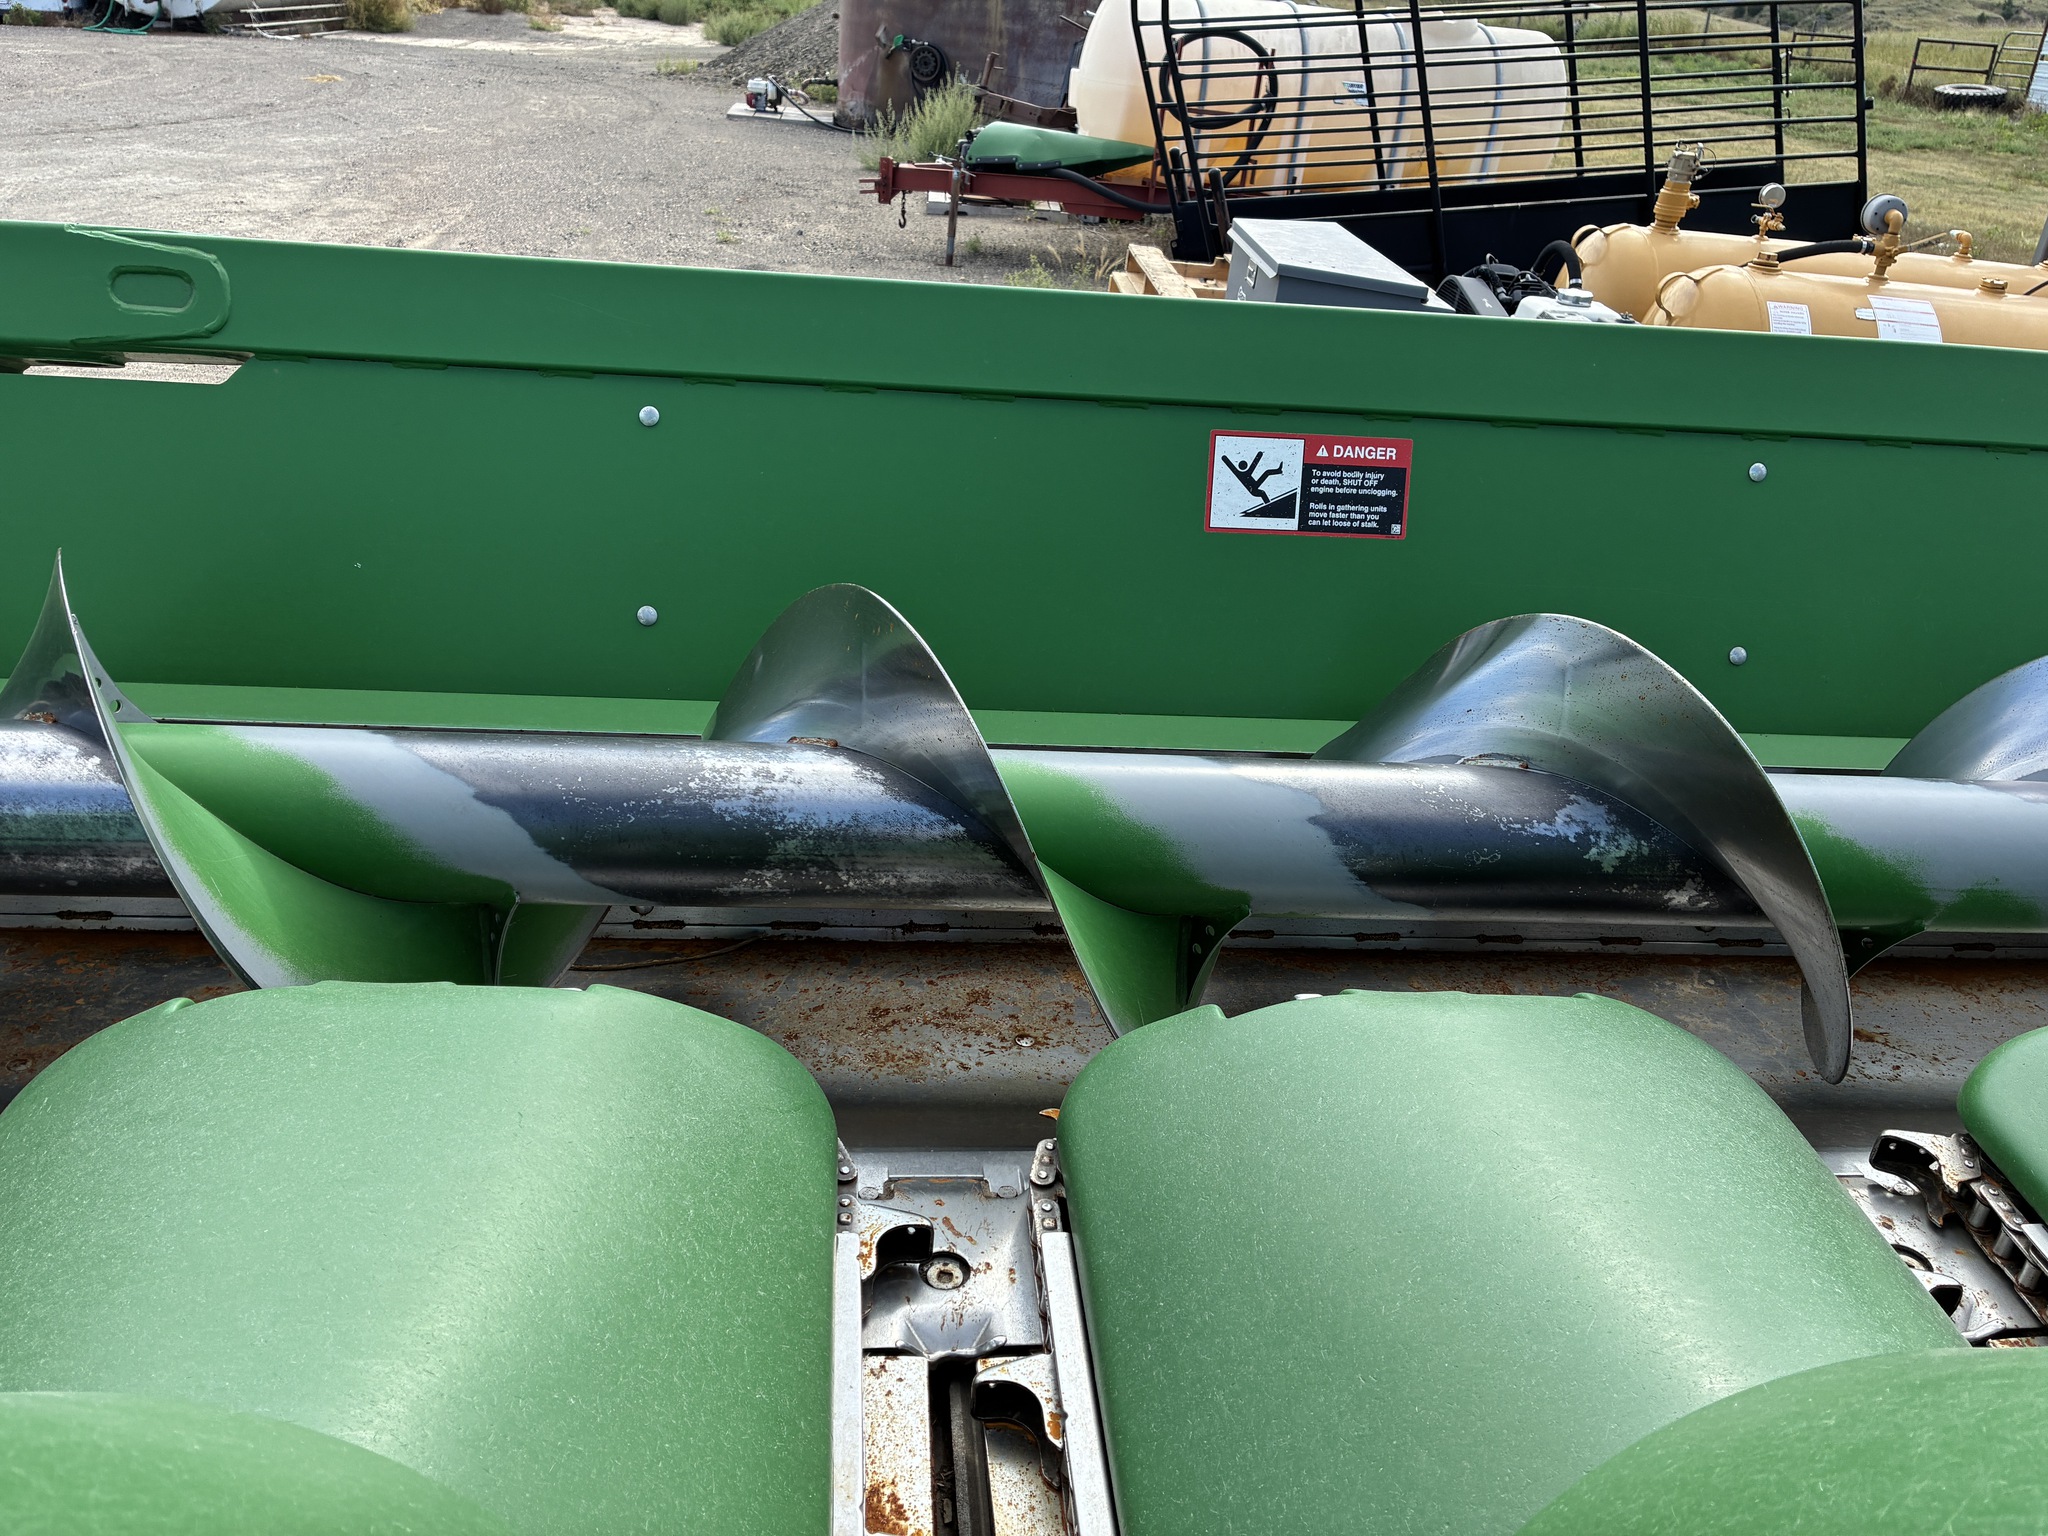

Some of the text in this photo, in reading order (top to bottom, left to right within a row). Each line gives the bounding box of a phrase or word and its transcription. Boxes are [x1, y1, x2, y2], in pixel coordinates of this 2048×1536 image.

[1333, 445, 1397, 460] DANGER
[1312, 469, 1321, 477] To
[1342, 471, 1364, 479] bodily
[1365, 472, 1385, 480] injury
[1320, 478, 1341, 486] death,
[1310, 486, 1334, 494] engine
[1358, 488, 1398, 497] unclogging.
[1309, 502, 1327, 510] Rolls
[1336, 504, 1369, 513] gathering
[1370, 505, 1387, 513] units
